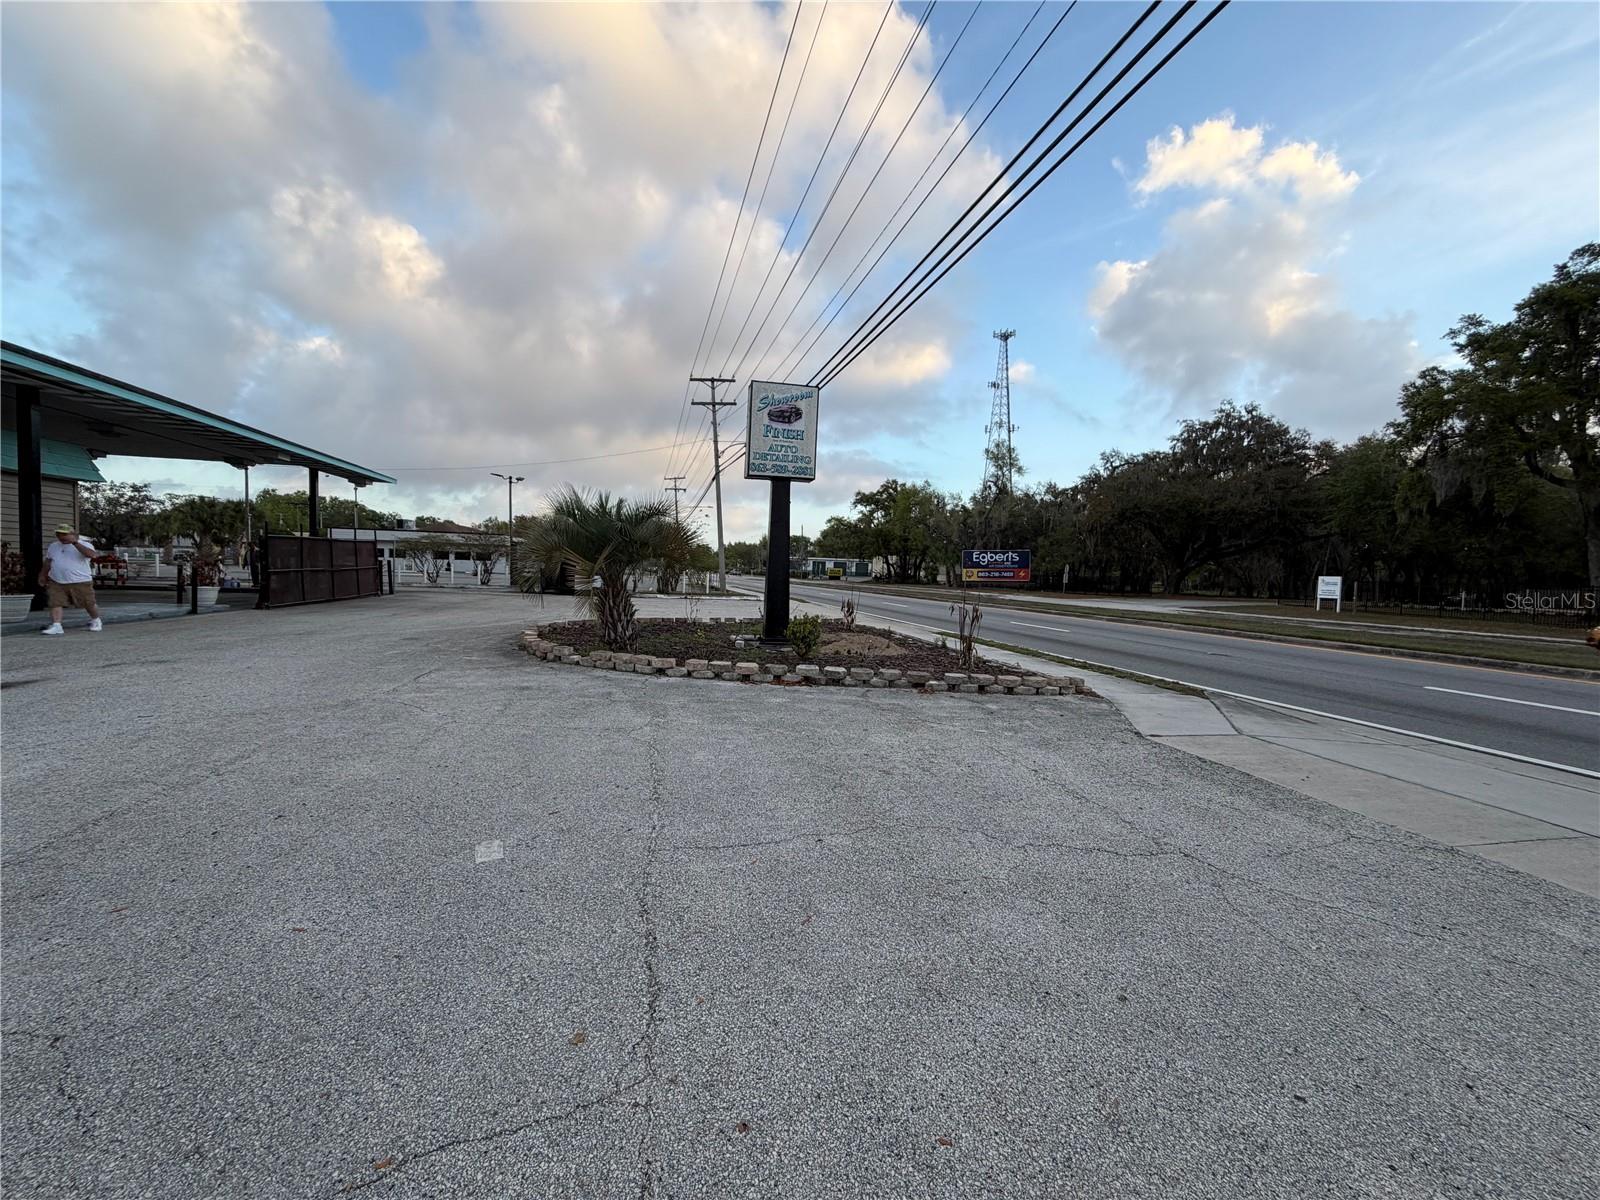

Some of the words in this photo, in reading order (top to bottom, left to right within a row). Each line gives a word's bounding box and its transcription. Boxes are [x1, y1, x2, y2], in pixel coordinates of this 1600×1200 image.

[757, 391, 814, 412] Showroom
[763, 424, 804, 440] FINISH
[768, 443, 798, 453] AUTO
[753, 452, 811, 464] DETAILING
[972, 551, 1020, 566] Egberts
